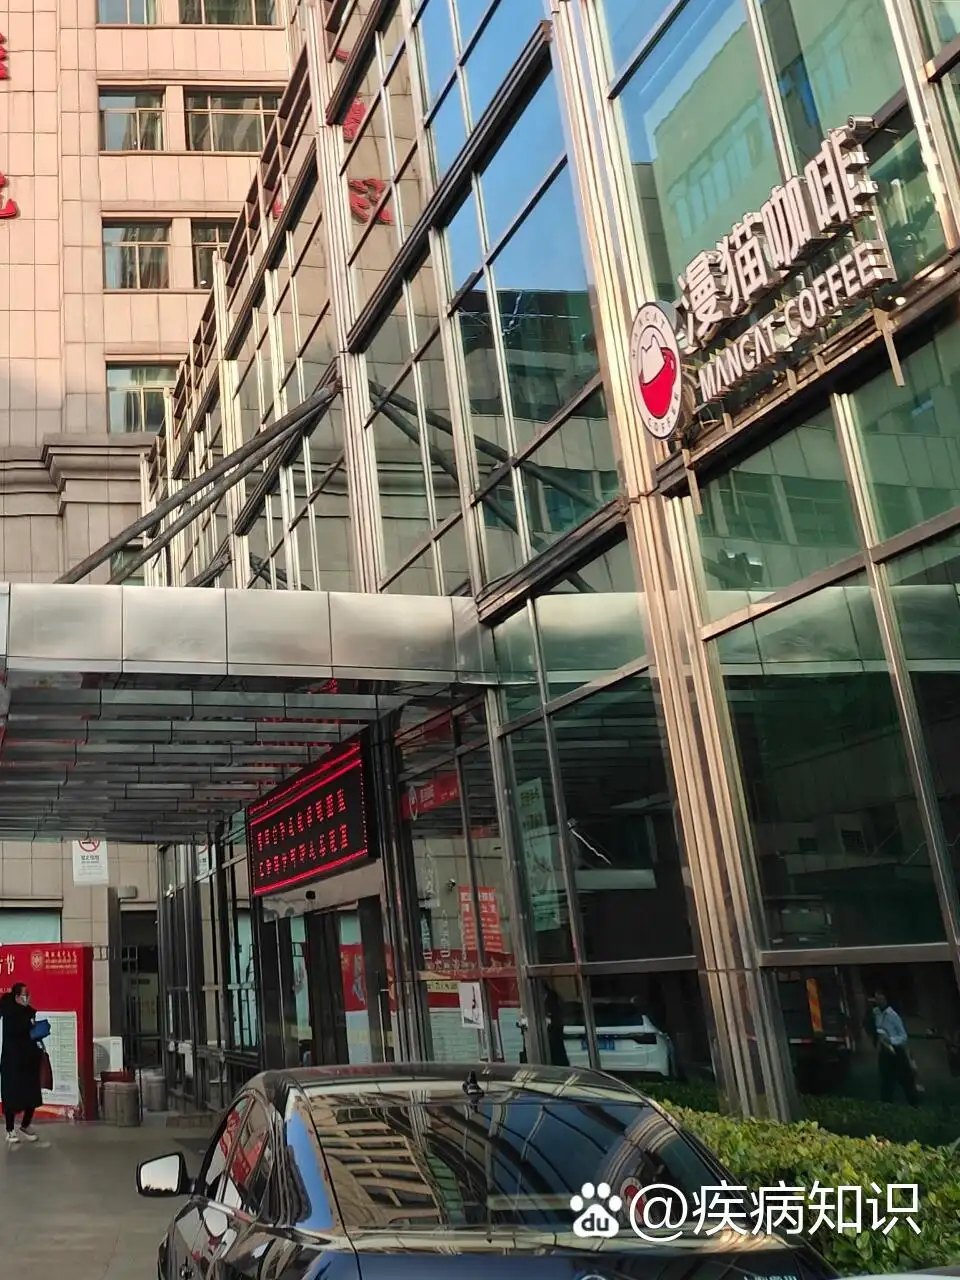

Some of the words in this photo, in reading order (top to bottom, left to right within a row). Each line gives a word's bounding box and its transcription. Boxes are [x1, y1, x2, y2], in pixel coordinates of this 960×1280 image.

[678, 128, 874, 356] 漫猫咖啡
[697, 317, 778, 403] MANCAT
[783, 241, 886, 338] COFFEE
